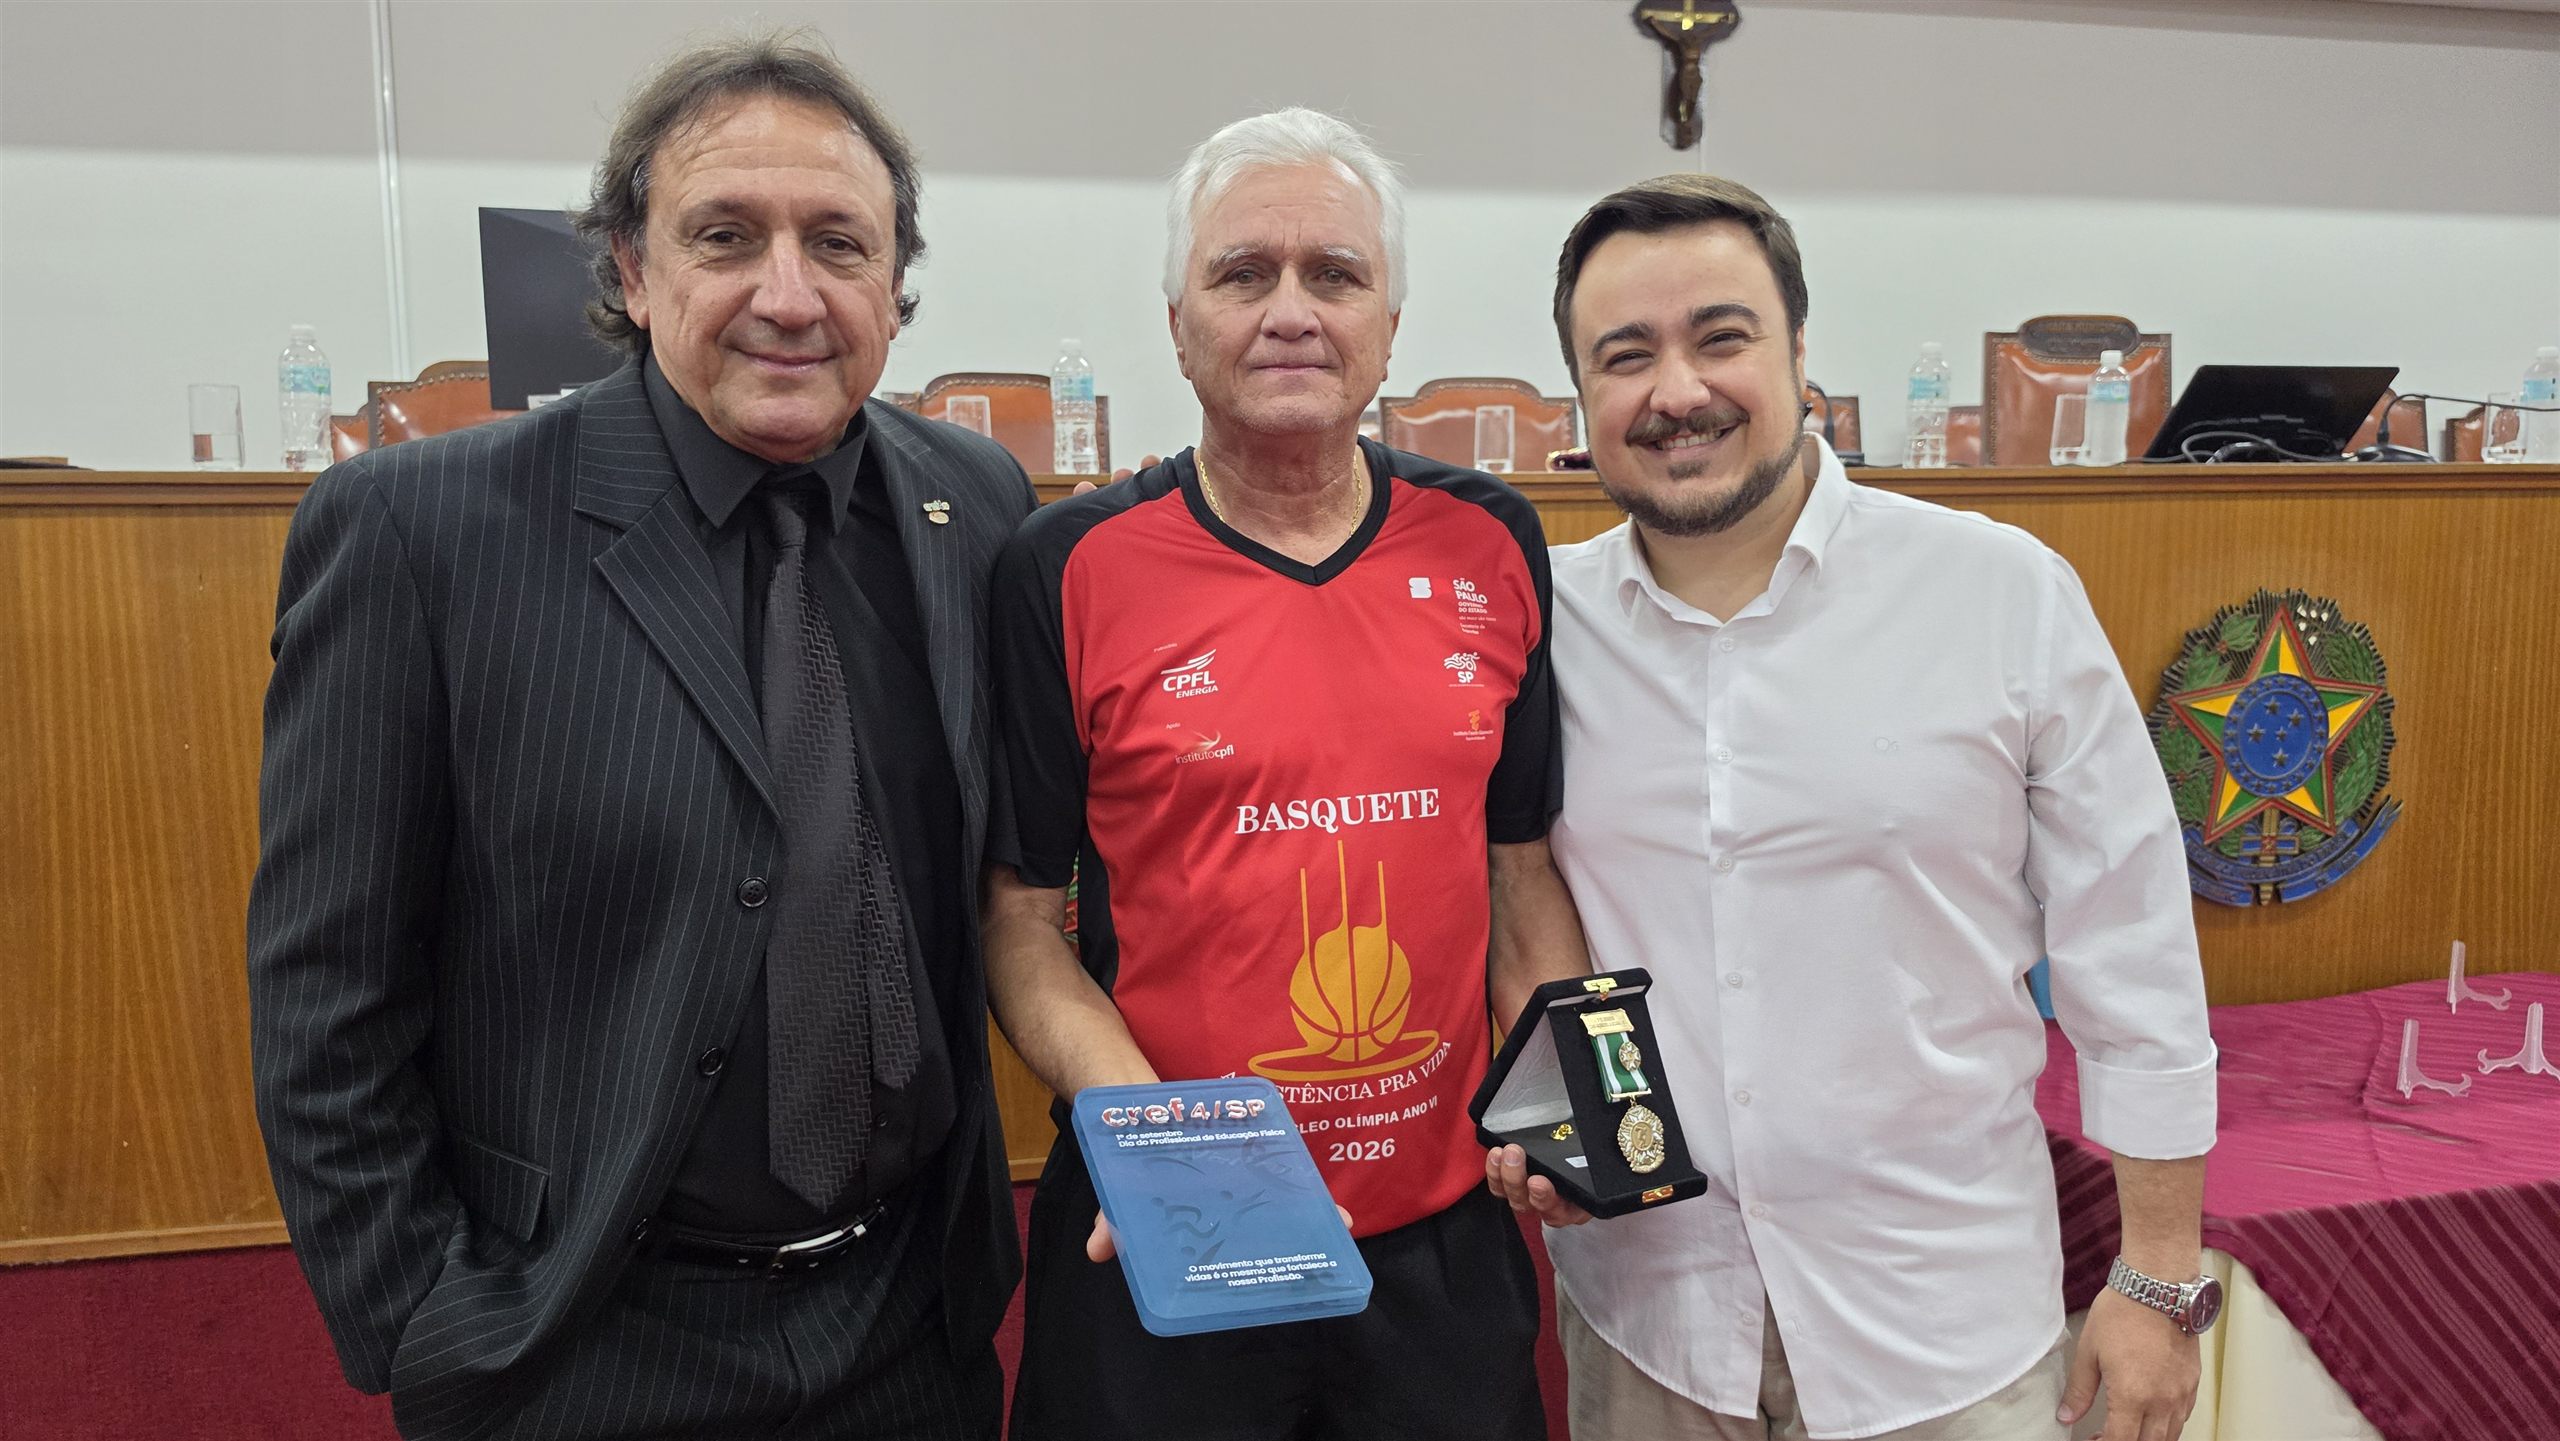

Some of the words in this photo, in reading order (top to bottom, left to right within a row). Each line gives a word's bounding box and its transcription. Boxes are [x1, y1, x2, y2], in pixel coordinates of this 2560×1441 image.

[1452, 577, 1475, 592] SÃO
[1455, 590, 1488, 605] PAULO
[1162, 670, 1216, 692] CPFL
[1457, 671, 1474, 683] SP
[1175, 685, 1219, 699] ENERGIA
[1235, 788, 1440, 834] BASQUETE
[1275, 1081, 1376, 1104] STÊNCIA
[1378, 1069, 1419, 1096] PRA
[1419, 1040, 1452, 1079] VIDA
[1334, 1109, 1400, 1129] OLÍMPIA
[1402, 1101, 1428, 1121] ANO
[1428, 1095, 1438, 1109] VI
[1118, 1139, 1135, 1148] Dia
[1136, 1138, 1149, 1147] do
[1150, 1134, 1202, 1146] Profissional
[1203, 1133, 1215, 1142] de
[1216, 1130, 1260, 1142] Educação
[1126, 1132, 1138, 1140] de
[1139, 1129, 1184, 1139] setembro
[1329, 1137, 1396, 1162] 2026
[1185, 1273, 1213, 1283] vidas
[1230, 1267, 1267, 1279] mesmo
[1267, 1265, 1287, 1275] que
[1287, 1261, 1329, 1273] fortalece
[1329, 1260, 1338, 1268] a
[1198, 1259, 1254, 1273] movimento
[1254, 1258, 1274, 1268] que
[1274, 1252, 1327, 1264] transforma
[1228, 1277, 1258, 1288] nossa
